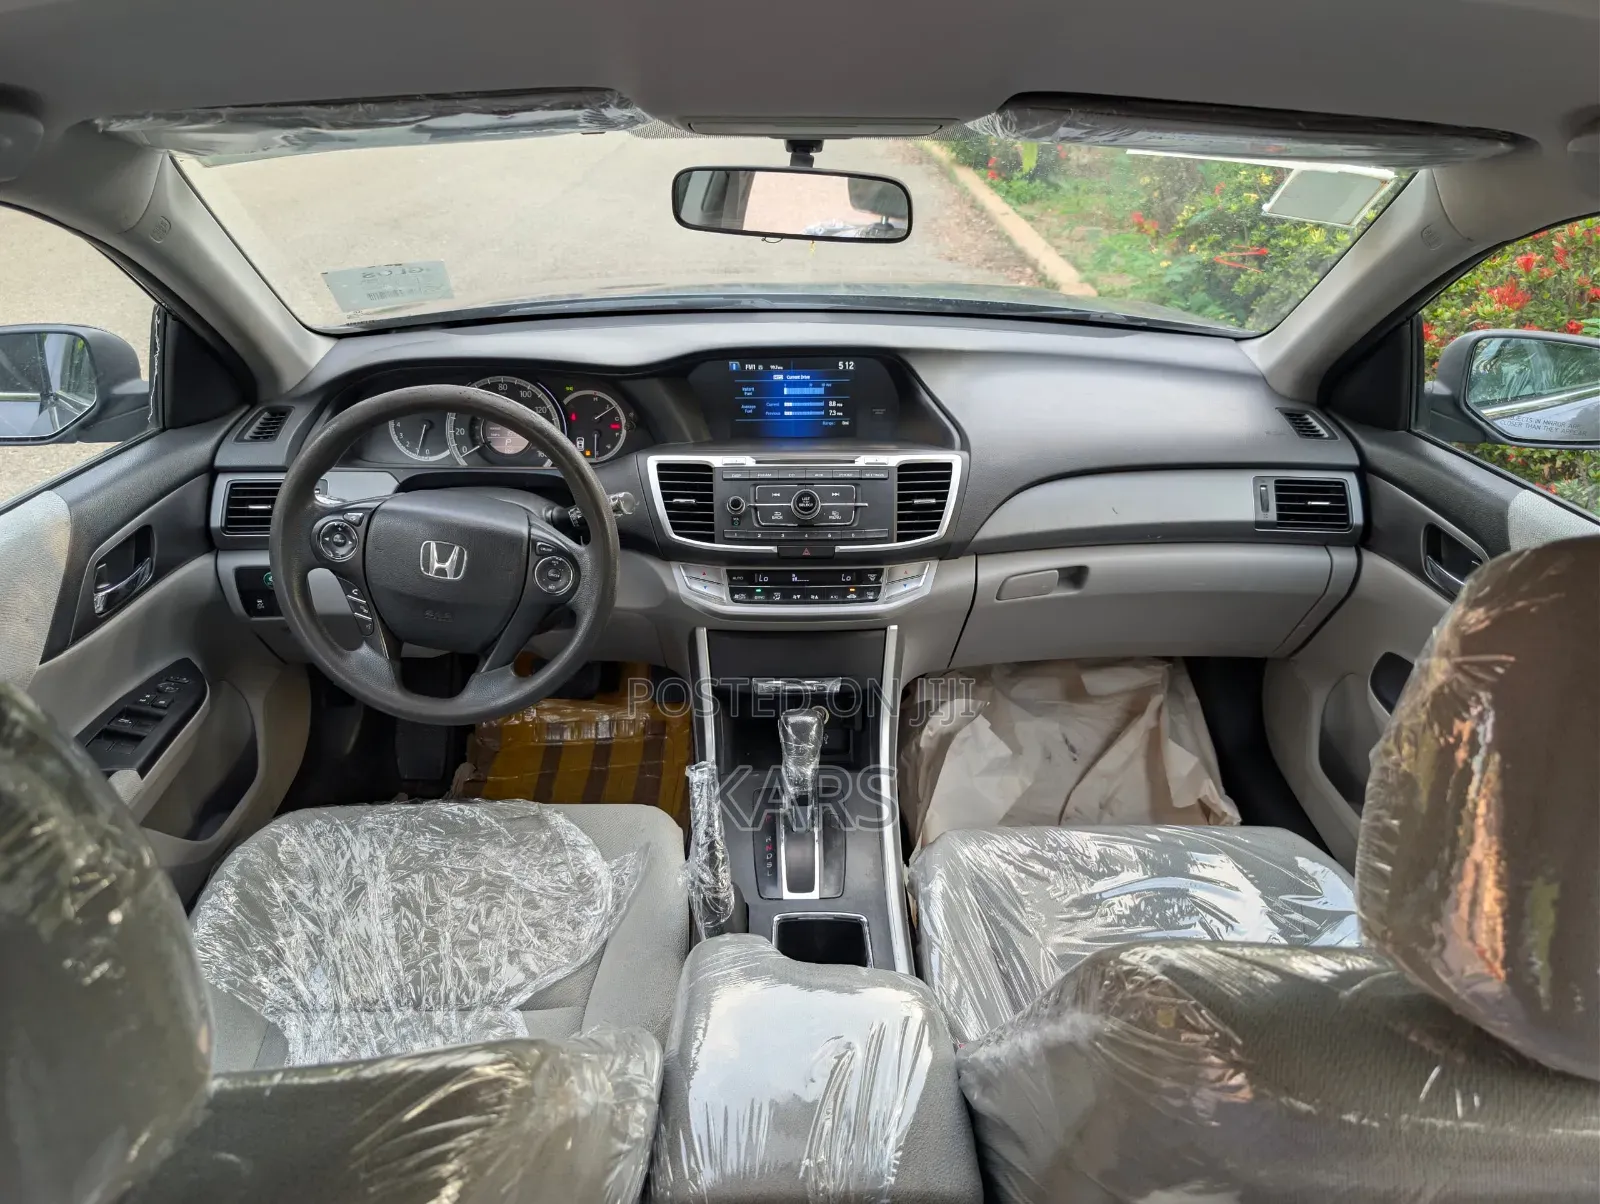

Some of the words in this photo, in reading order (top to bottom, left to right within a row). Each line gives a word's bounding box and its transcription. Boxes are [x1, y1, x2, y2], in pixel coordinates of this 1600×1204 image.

[535, 406, 547, 414] 120
[1543, 419, 1566, 428] MIRROR
[455, 428, 465, 436] 20
[1500, 420, 1522, 428] CLOSER
[1525, 422, 1541, 430] THAN
[1543, 425, 1559, 433] THEY
[1562, 428, 1588, 437] APPEAR
[758, 574, 769, 582] Lo
[841, 573, 851, 582] Lo
